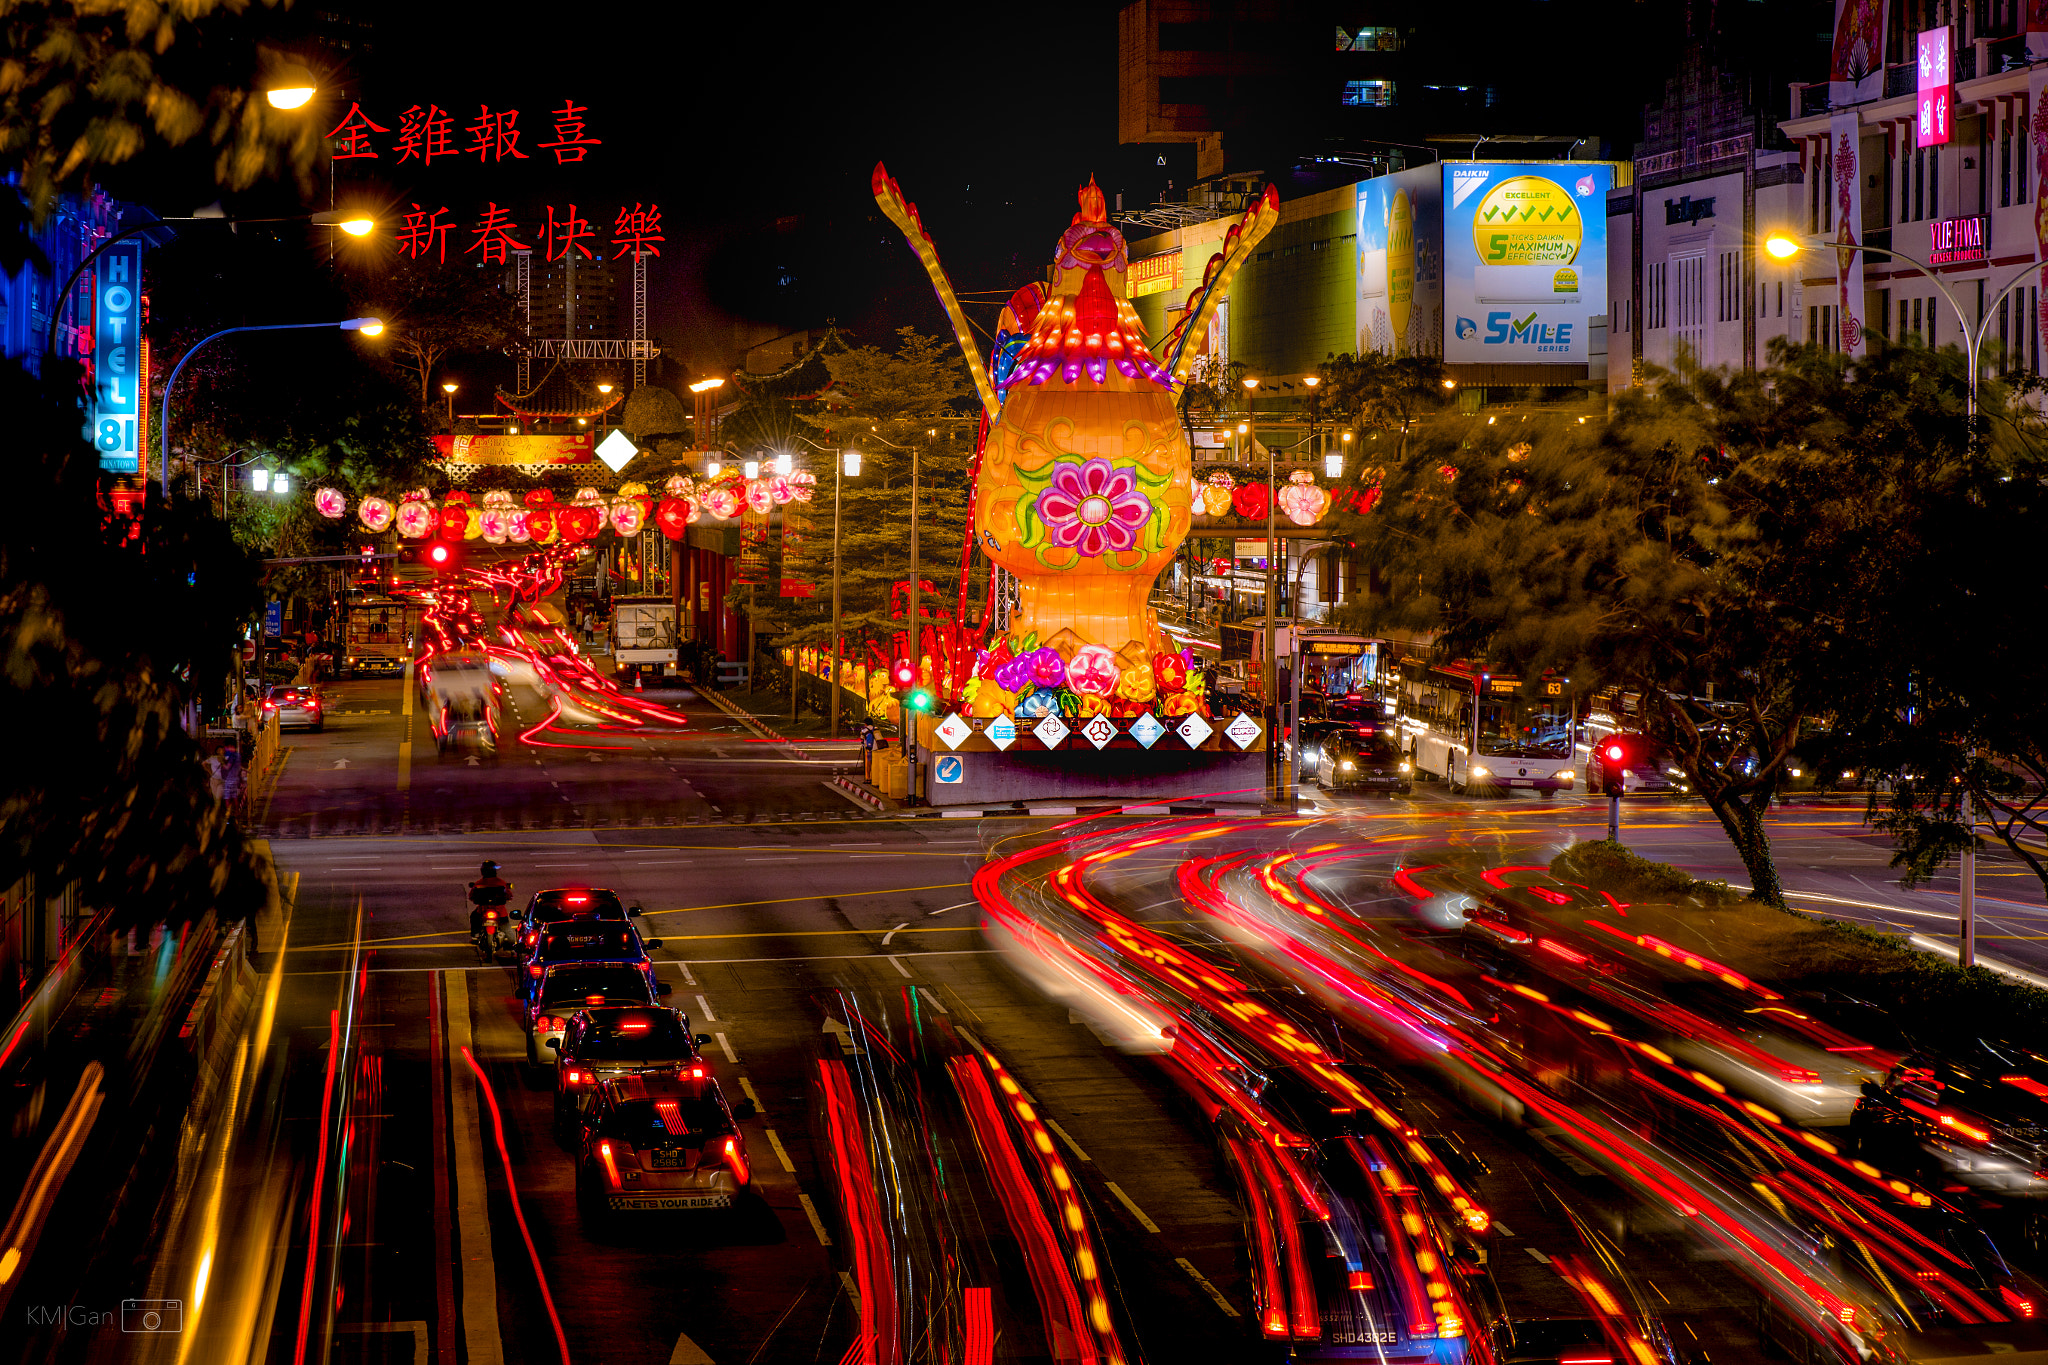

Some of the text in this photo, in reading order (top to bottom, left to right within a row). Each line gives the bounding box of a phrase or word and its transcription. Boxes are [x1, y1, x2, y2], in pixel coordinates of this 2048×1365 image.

[1930, 218, 1981, 251] YUE HWA
[1488, 234, 1508, 260] 5
[1509, 243, 1563, 251] MAXIMUM
[1930, 249, 1982, 264] CHINESE PRODUCTS
[104, 255, 132, 404] HOTEL
[1537, 345, 1570, 353] SERIES
[98, 418, 134, 452] 81
[99, 458, 136, 469] HINATOWN
[1548, 683, 1561, 695] 63
[660, 1150, 678, 1158] SHD
[626, 1198, 713, 1209] NETS YOUR RIDE
